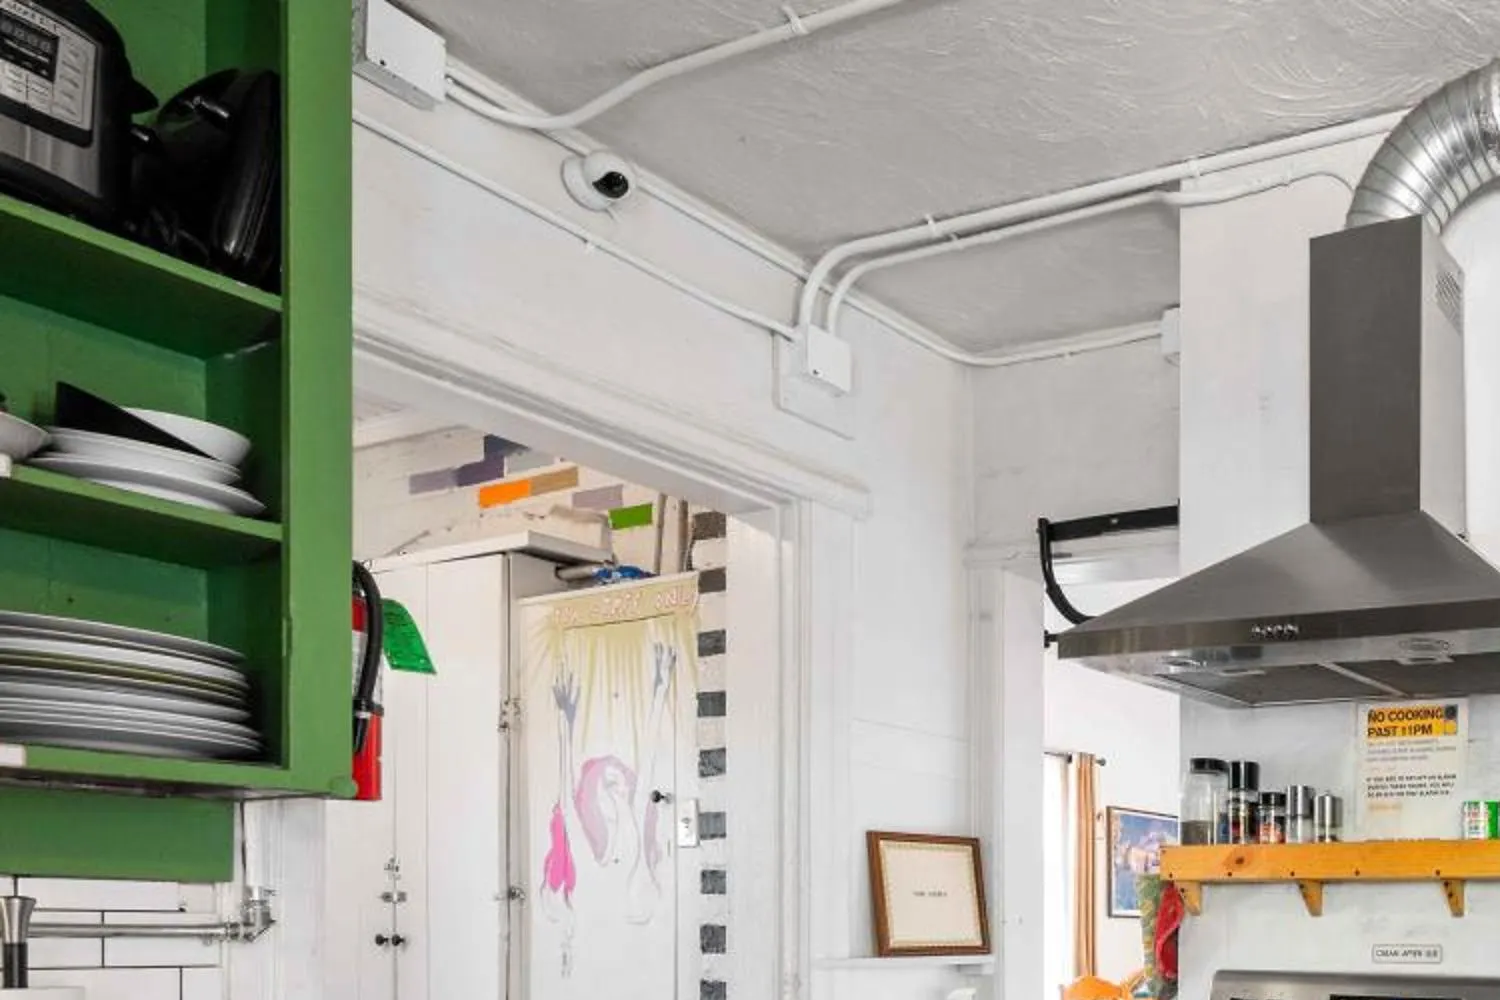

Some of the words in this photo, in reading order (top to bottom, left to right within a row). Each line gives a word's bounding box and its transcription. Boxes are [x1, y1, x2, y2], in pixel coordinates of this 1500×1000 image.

[1367, 709, 1385, 723] NO
[1387, 707, 1444, 722] COOKING
[1367, 726, 1397, 737] PAST
